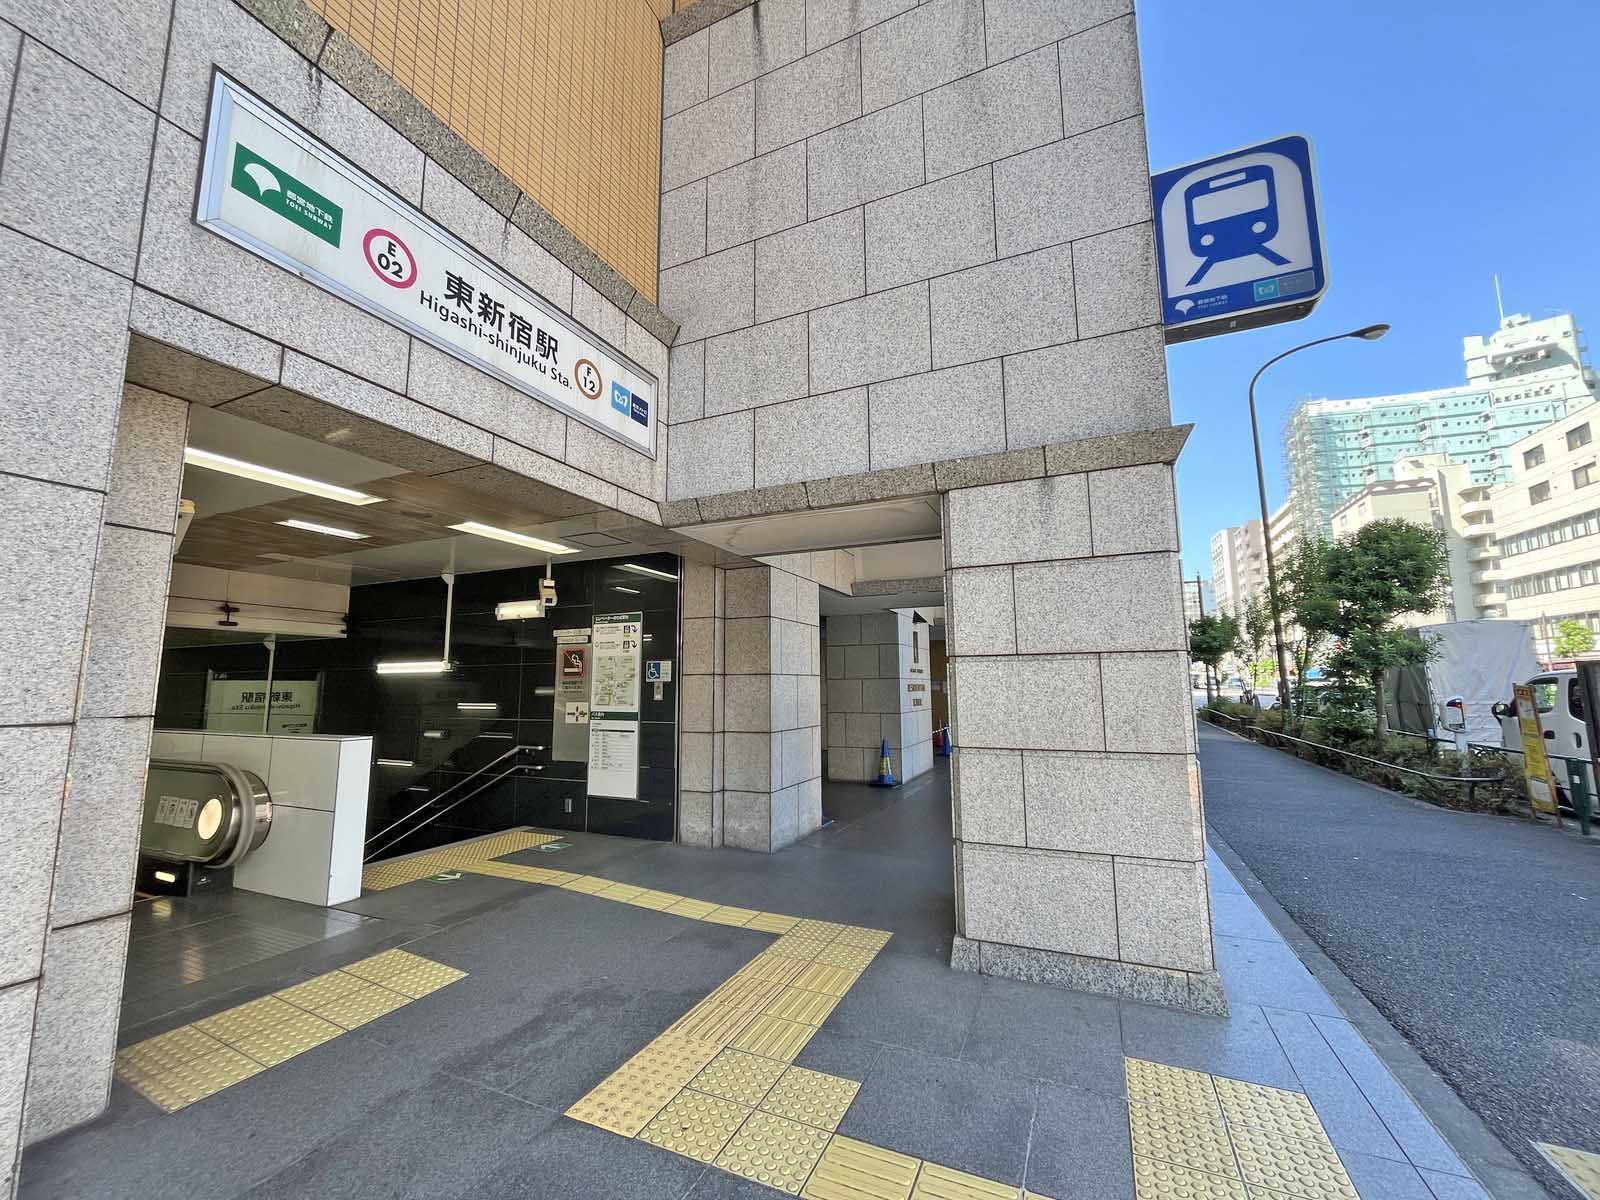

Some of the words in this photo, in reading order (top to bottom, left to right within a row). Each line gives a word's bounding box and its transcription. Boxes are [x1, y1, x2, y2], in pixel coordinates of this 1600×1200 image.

[285, 198, 302, 213] TOEI
[304, 209, 333, 231] SUBWAY
[387, 240, 397, 258] E
[377, 253, 404, 279] 02
[444, 270, 559, 365] 東新宿駅
[419, 290, 547, 375] Higashi-shinjuku
[551, 366, 574, 390] Sta.
[583, 377, 596, 393] 12
[587, 367, 593, 378] F
